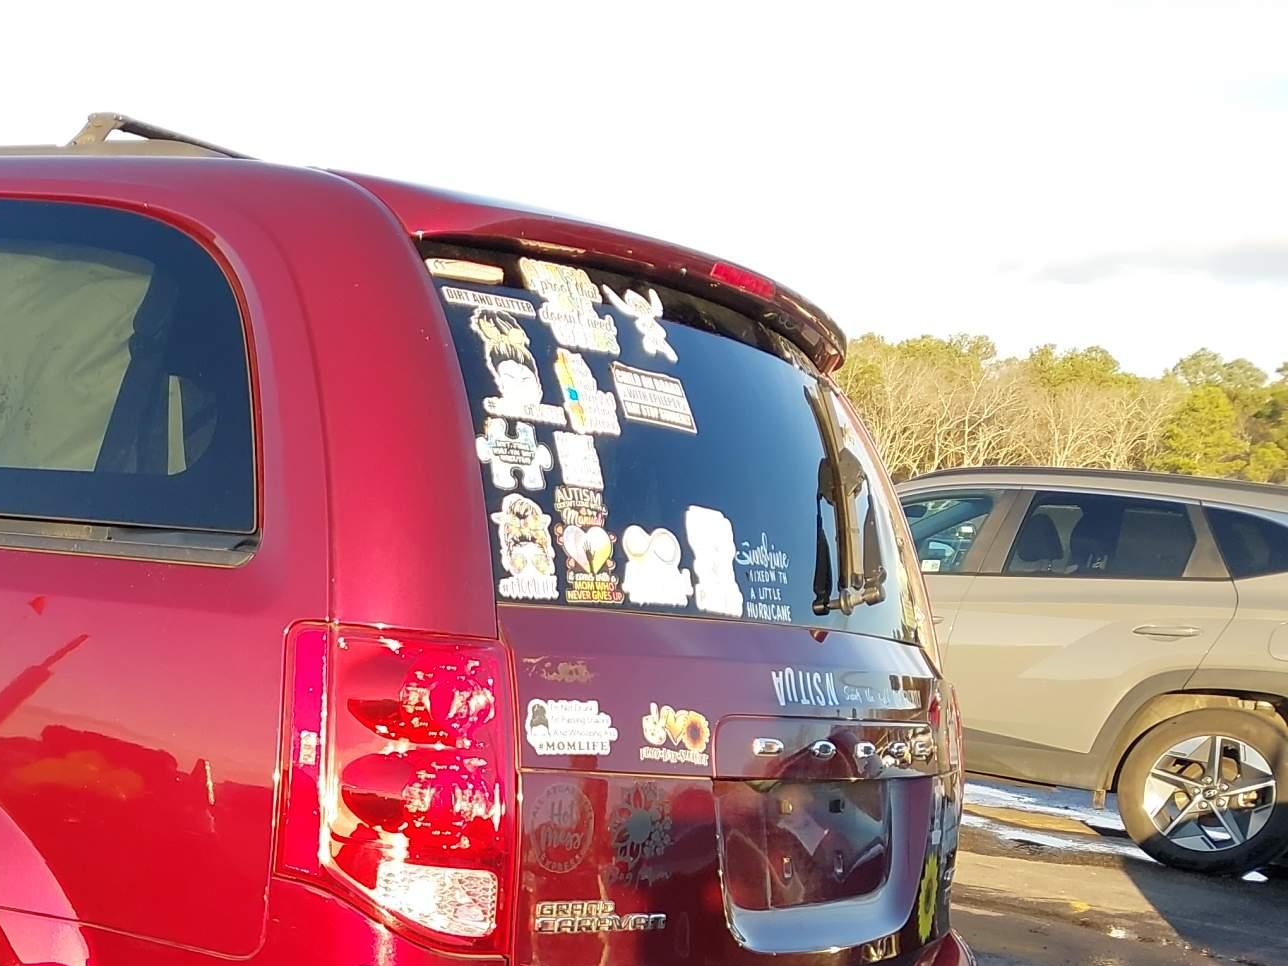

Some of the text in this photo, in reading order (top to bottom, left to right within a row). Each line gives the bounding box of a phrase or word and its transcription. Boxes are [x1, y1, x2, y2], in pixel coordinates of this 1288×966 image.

[446, 288, 534, 313] DIRT AND GLITTER
[556, 486, 602, 506] AUTISM
[735, 532, 790, 569] Sunshine
[769, 570, 788, 585] WTH
[575, 581, 615, 592] MOM WHO
[750, 587, 781, 601] A LITTLE
[568, 590, 591, 600] NEVER
[612, 592, 623, 602] UP
[746, 601, 792, 622] HURRICANE
[538, 740, 608, 752] #MOMLIFE
[752, 738, 934, 761] DODGE
[535, 901, 616, 916] GRAND
[535, 914, 667, 934] CARAVAN
